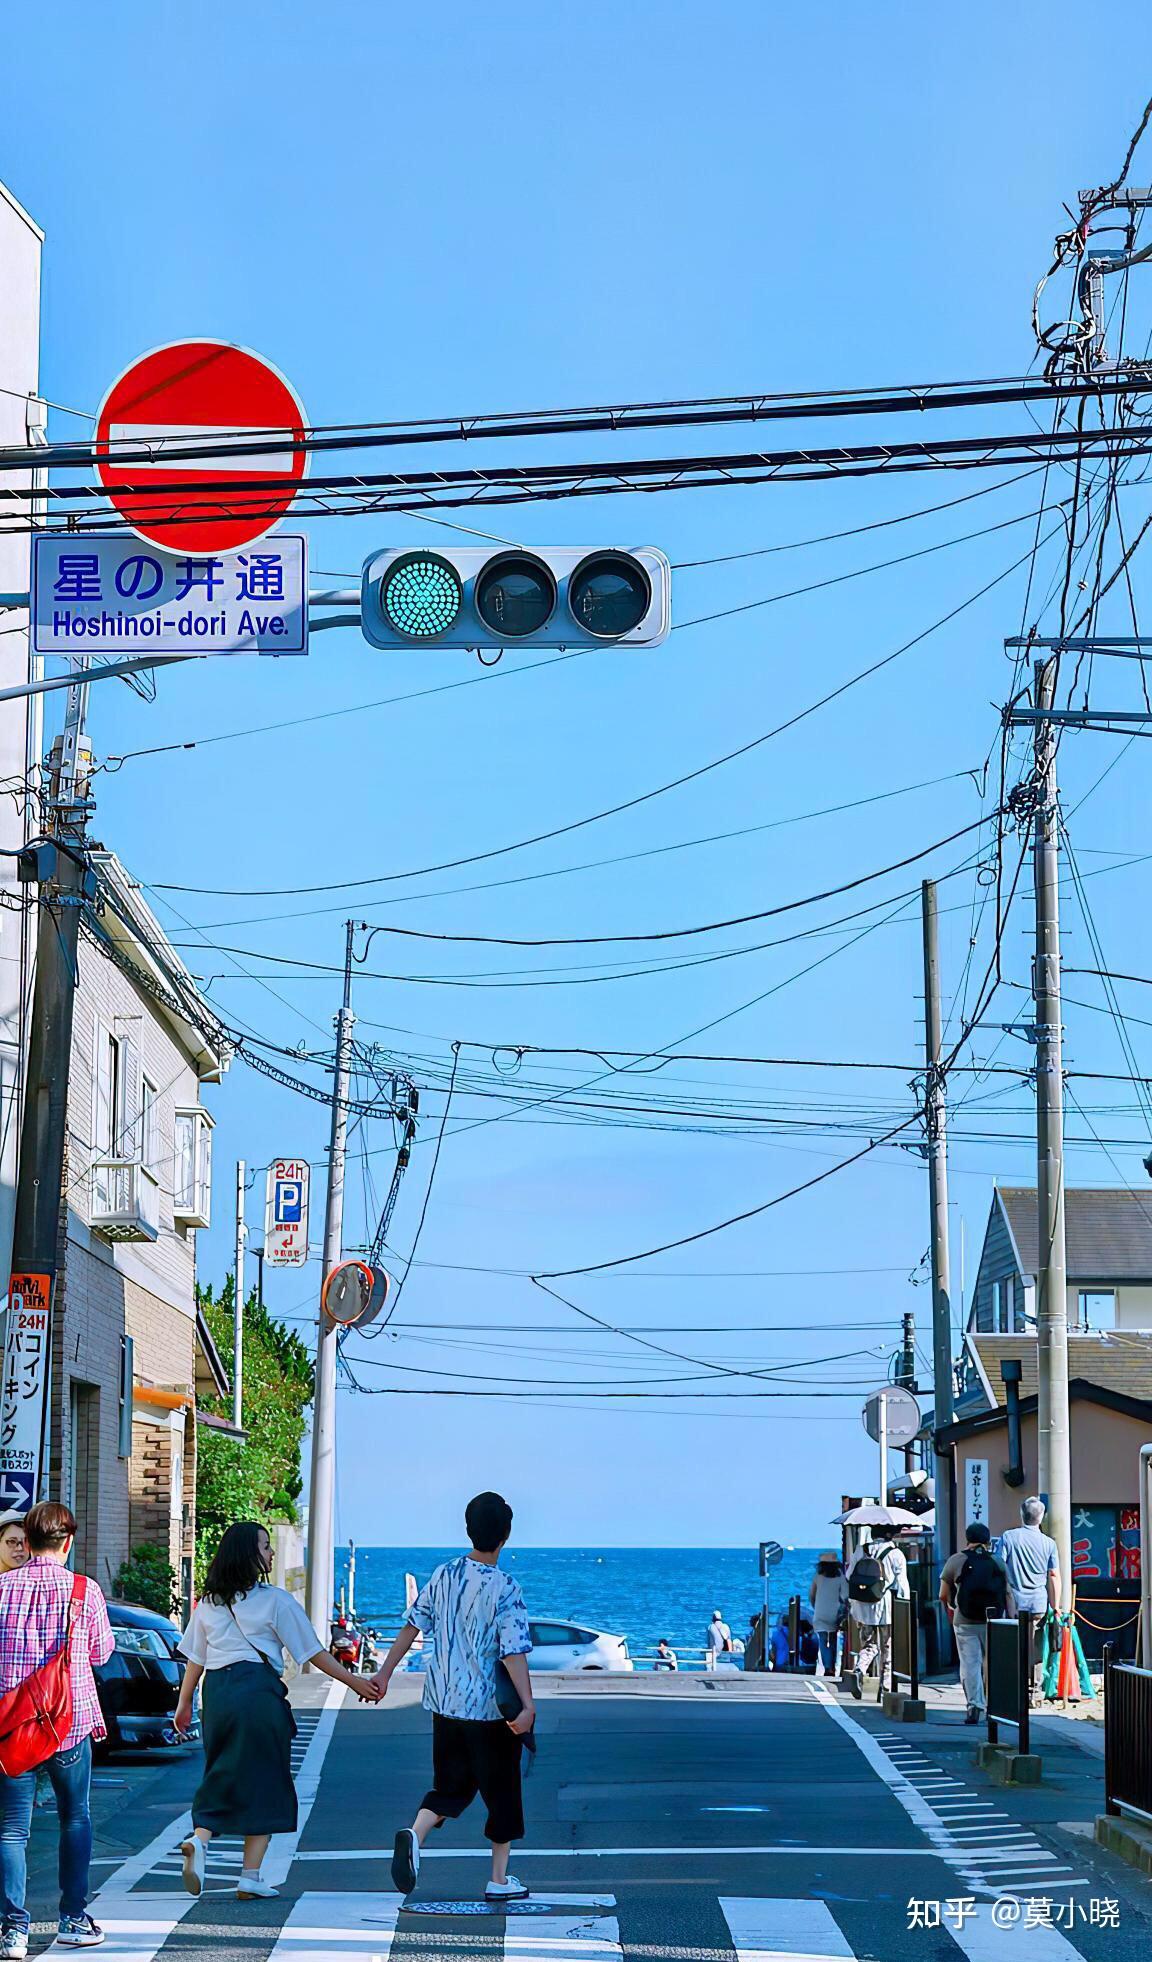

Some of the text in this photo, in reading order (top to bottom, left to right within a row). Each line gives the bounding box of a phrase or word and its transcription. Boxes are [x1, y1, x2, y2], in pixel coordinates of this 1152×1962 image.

[53, 554, 285, 602] 星の井通
[53, 610, 289, 637] Hoshinoi-dori Ave.
[275, 1162, 303, 1180] 24h
[278, 1184, 299, 1220] P
[18, 1314, 46, 1330] 24H
[22, 1335, 41, 1399] コイン
[1, 1331, 23, 1446] パーキング
